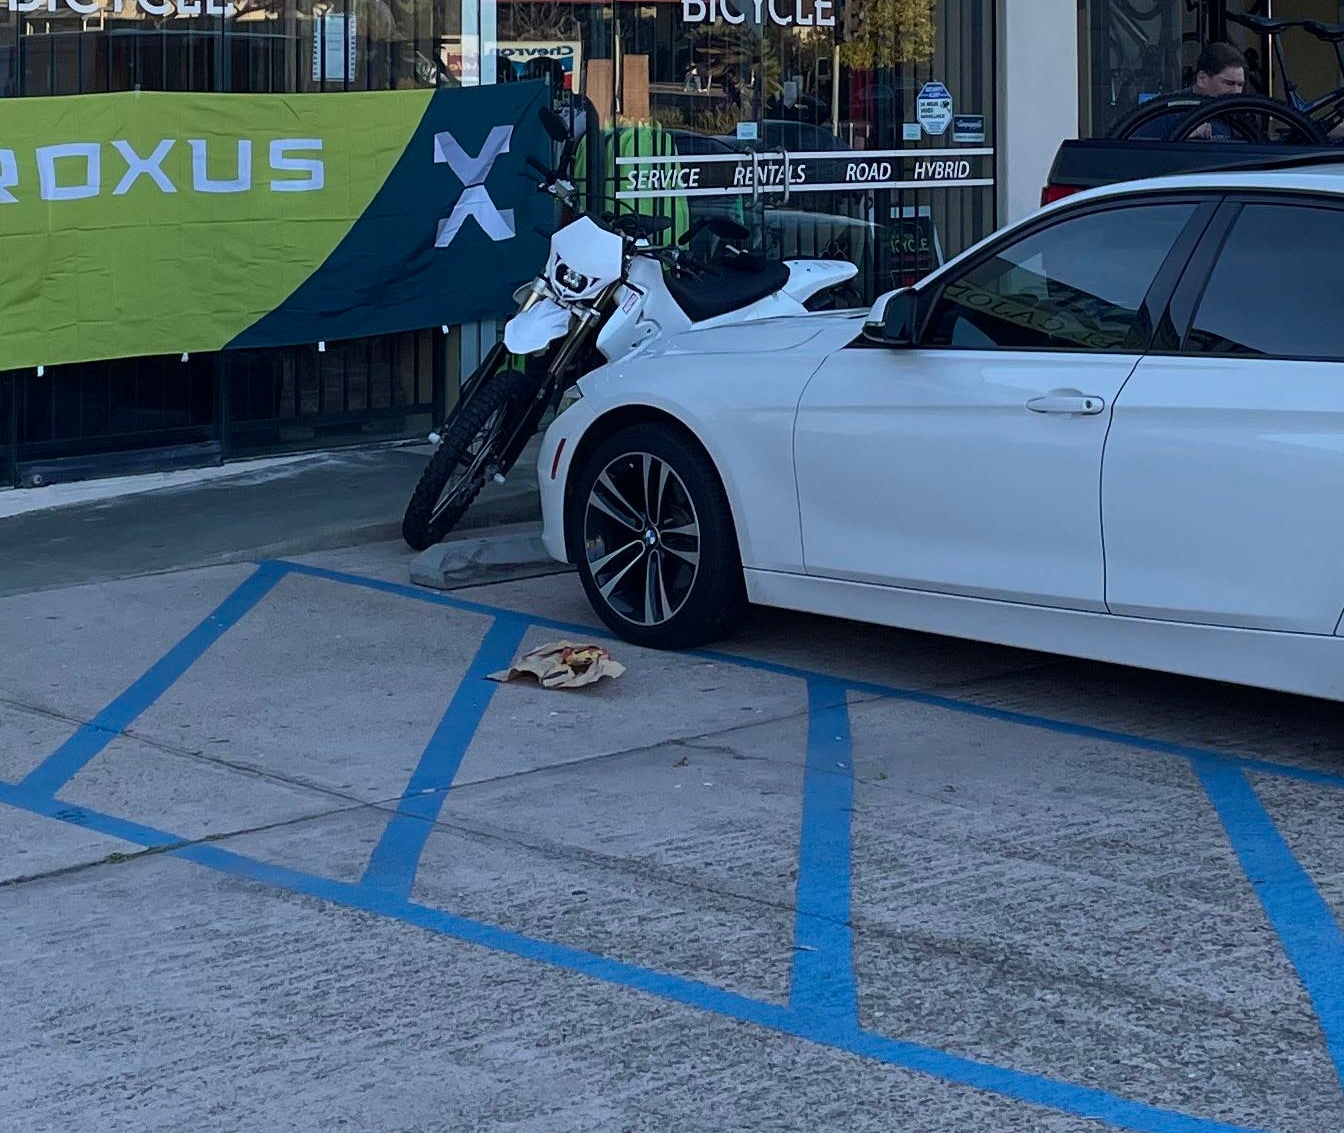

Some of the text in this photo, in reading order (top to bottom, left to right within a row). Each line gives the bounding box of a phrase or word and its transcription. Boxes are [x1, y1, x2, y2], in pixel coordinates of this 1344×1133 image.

[626, 160, 970, 189] SERVICE RENTALS ROAD HYBRID
